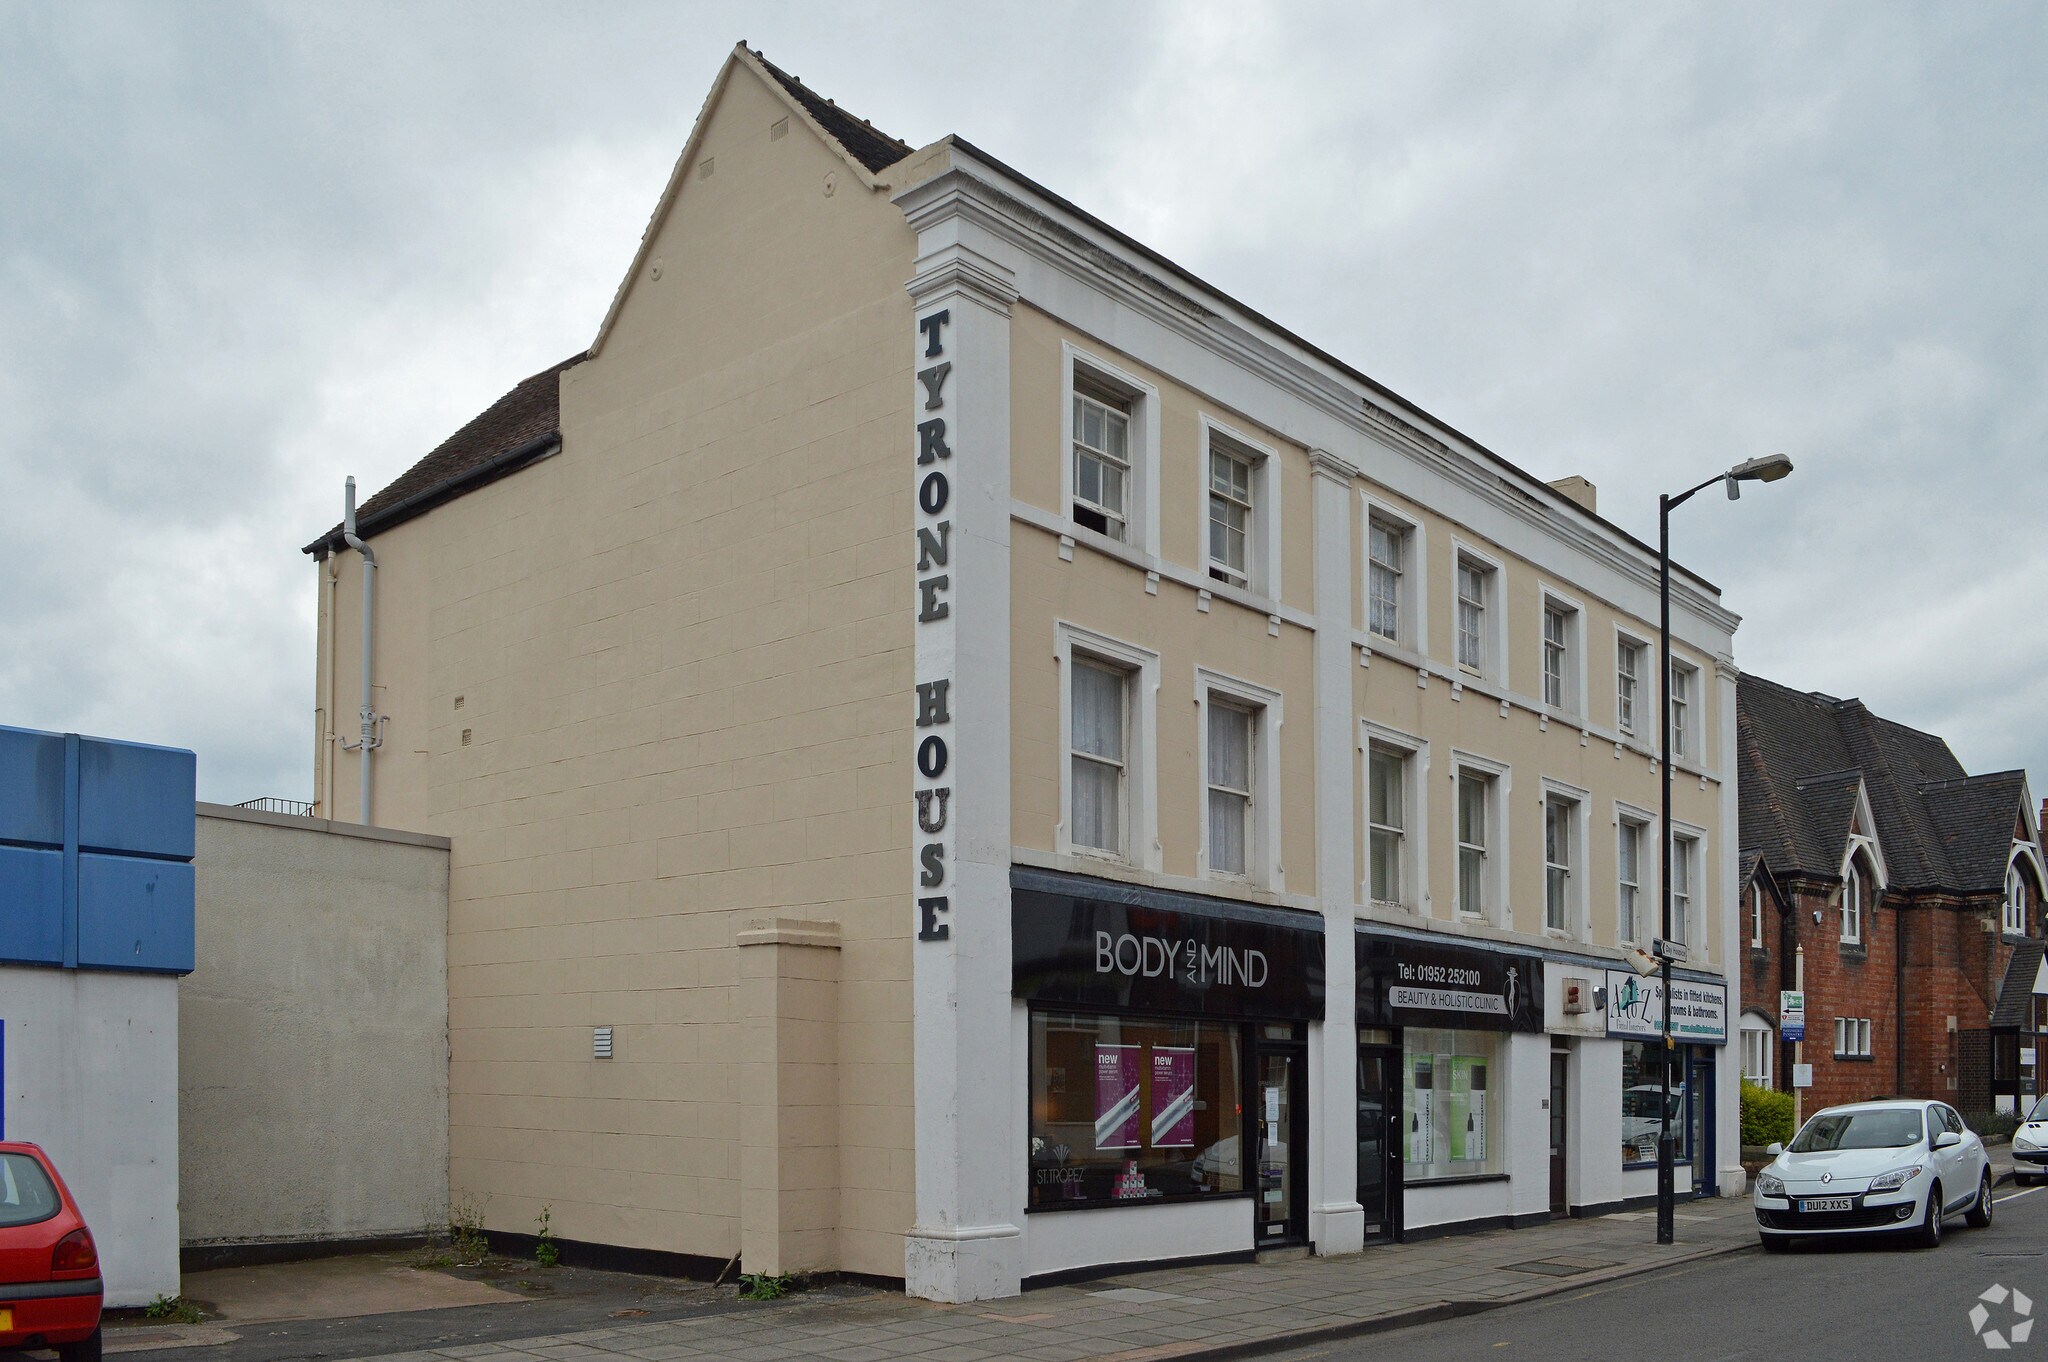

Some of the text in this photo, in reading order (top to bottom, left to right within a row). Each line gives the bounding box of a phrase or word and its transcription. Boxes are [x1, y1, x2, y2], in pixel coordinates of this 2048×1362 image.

[915, 309, 951, 942] TYRONE HOUSE
[1096, 930, 1268, 988] BODY AND MIND
[1398, 963, 1481, 986] Tel: 01952 252100
[1397, 990, 1499, 1011] BEAUTY & HOLISTIC CLINIC
[1683, 989, 1689, 1001] in
[1689, 989, 1702, 1003] fitted
[1610, 984, 1622, 1019] A
[1640, 988, 1654, 1024] Z
[1687, 1004, 1692, 1017] &
[1098, 1054, 1118, 1064] new
[1154, 1056, 1173, 1066] new
[1452, 1069, 1468, 1080] SKIN
[1806, 1200, 1849, 1211] DU12 XXS
